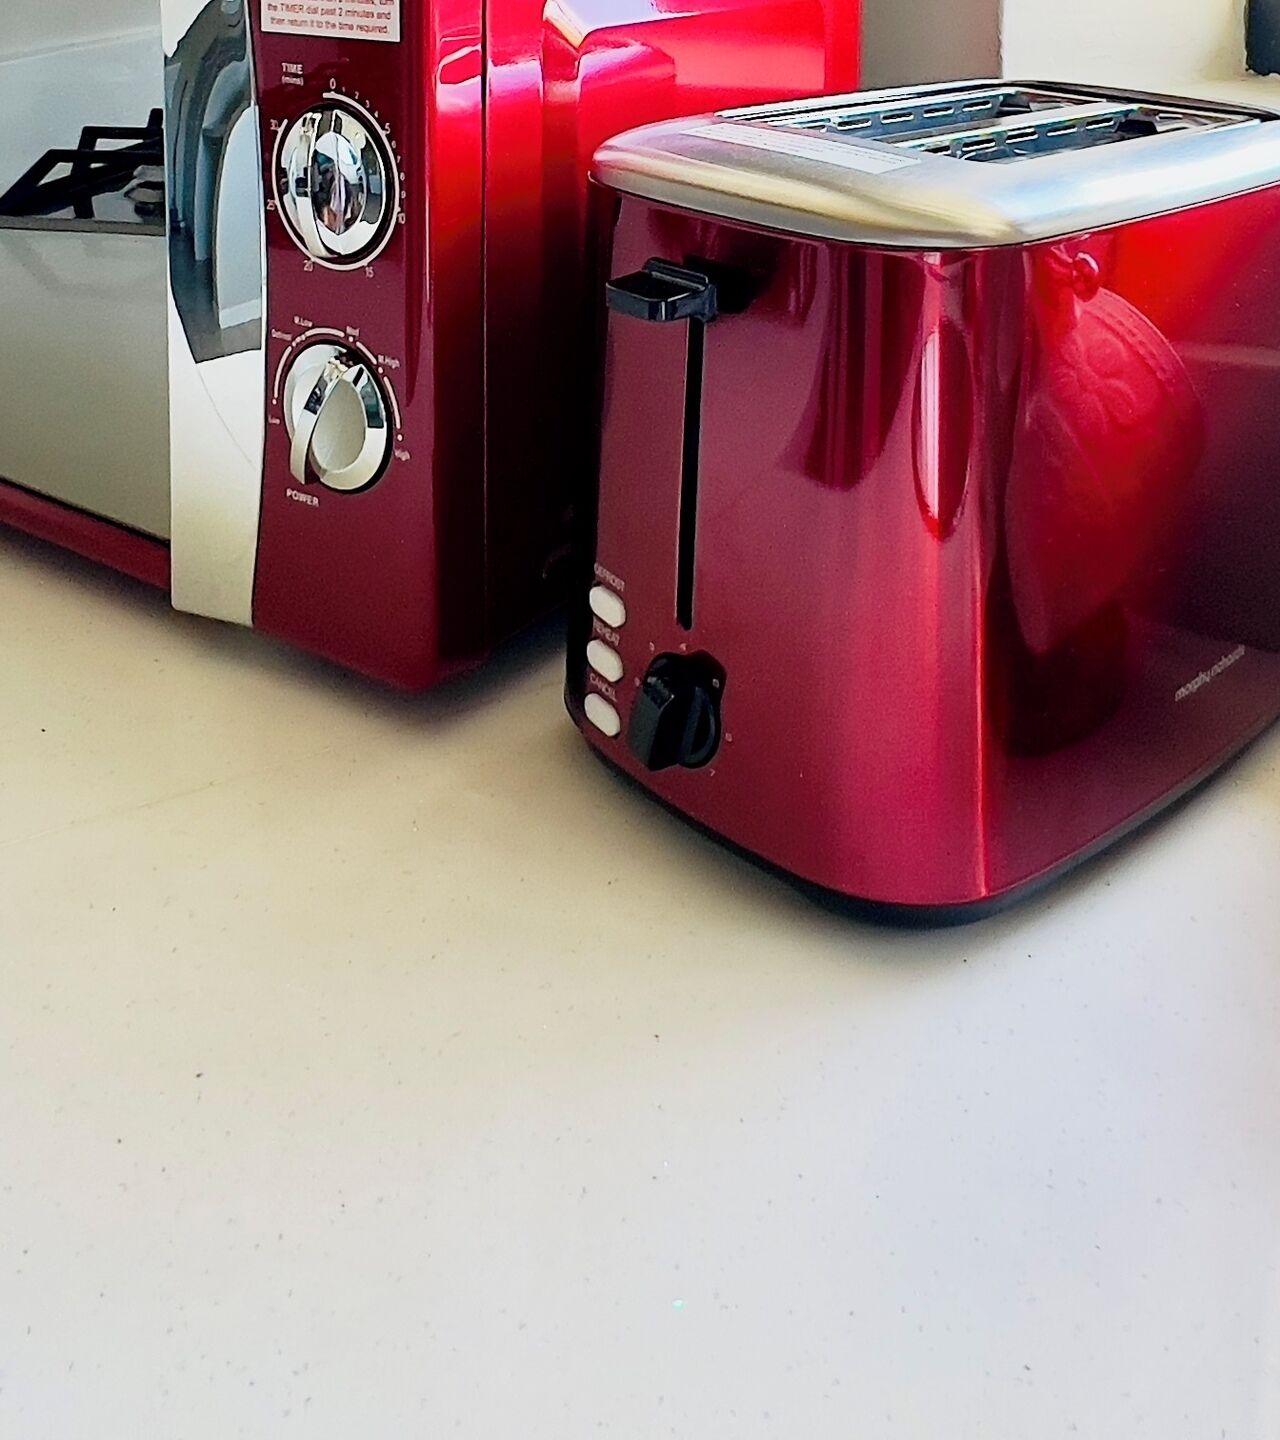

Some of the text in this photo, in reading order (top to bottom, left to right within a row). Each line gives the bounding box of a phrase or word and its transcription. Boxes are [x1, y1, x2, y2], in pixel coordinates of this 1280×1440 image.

[338, 7, 344, 17] 2
[281, 62, 304, 75] TIME
[329, 78, 337, 90] 0
[354, 90, 360, 100] 2
[384, 122, 391, 135] 5
[286, 488, 320, 507] POWER
